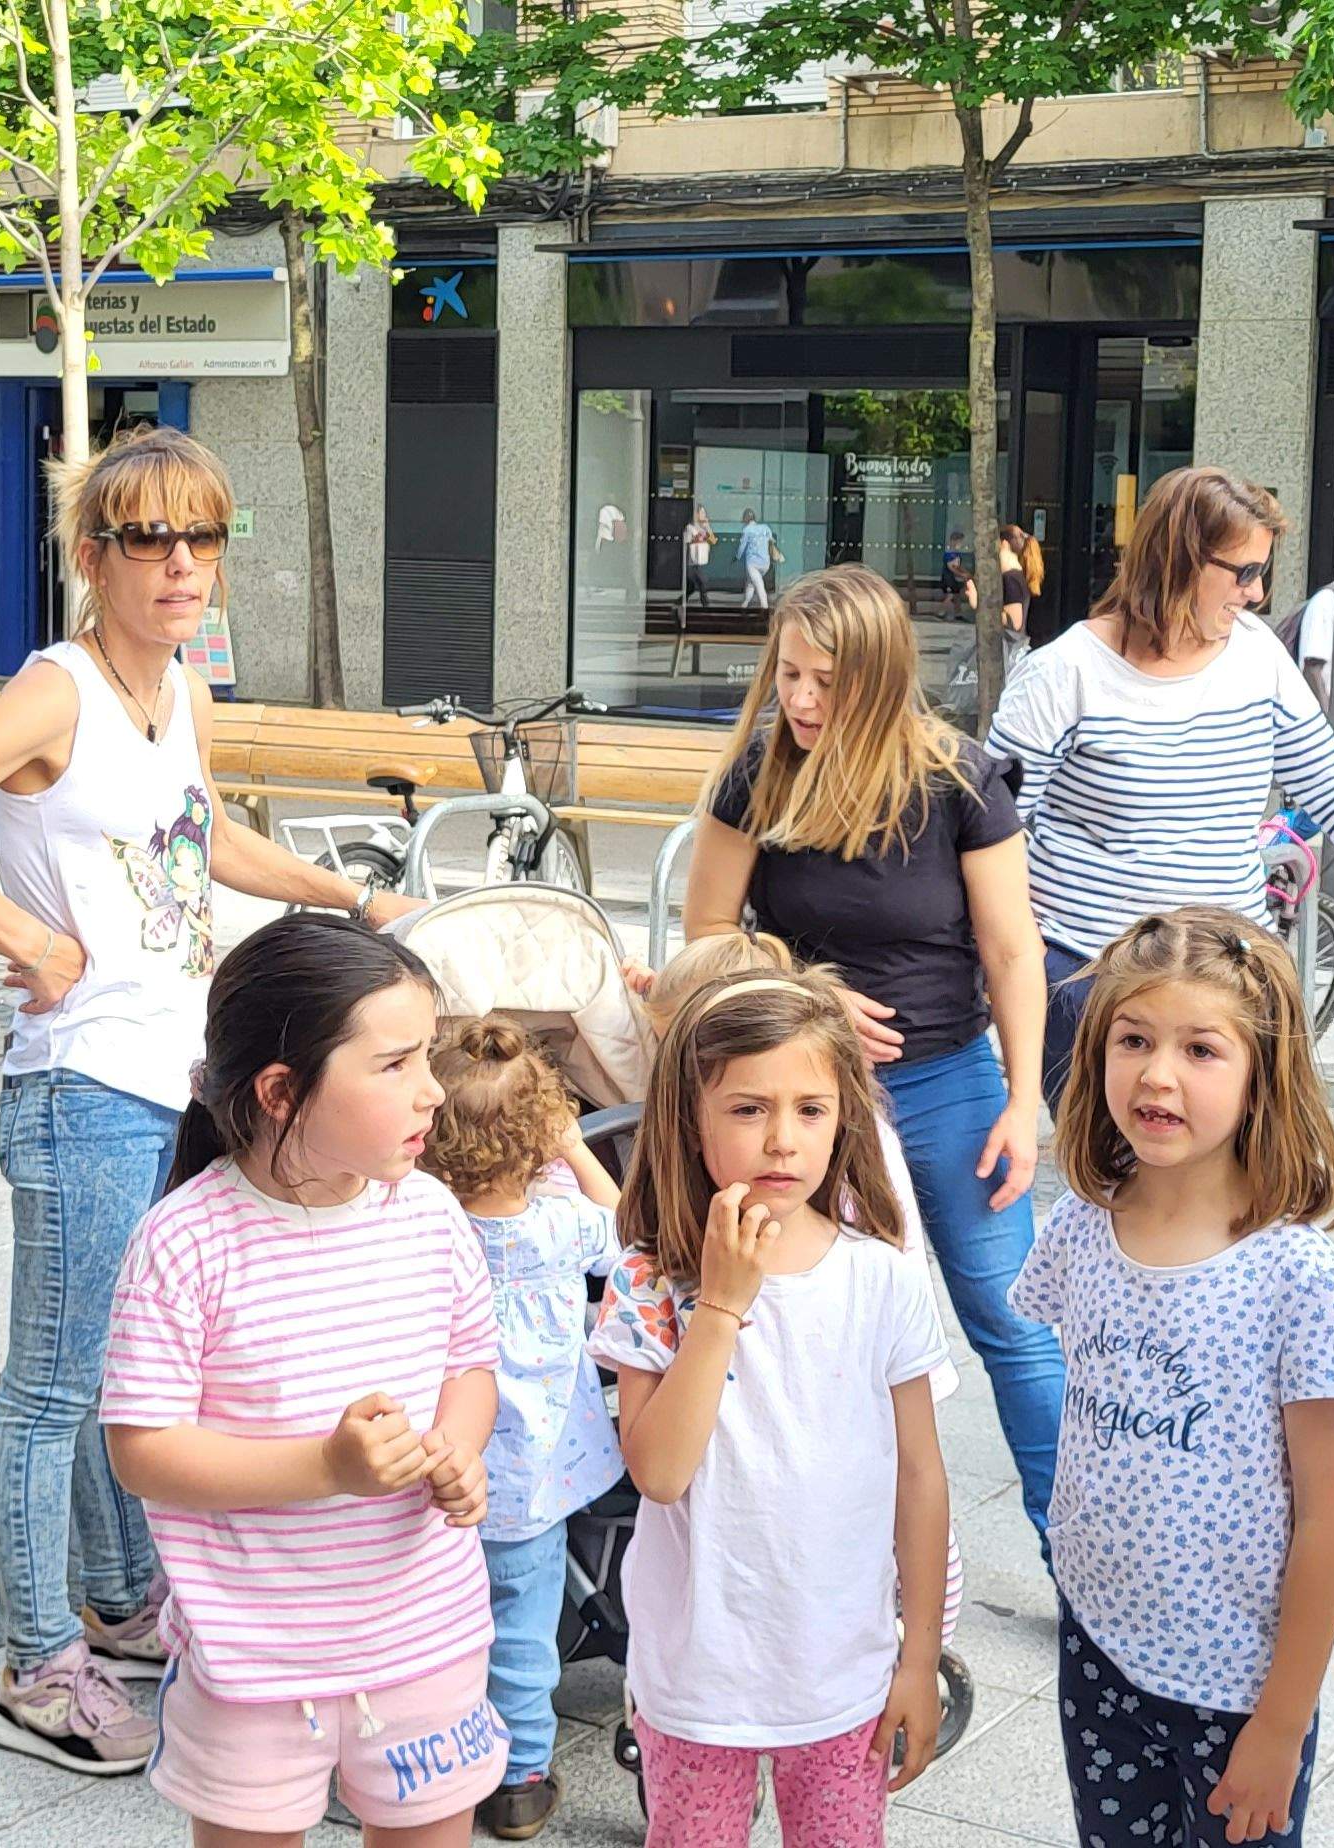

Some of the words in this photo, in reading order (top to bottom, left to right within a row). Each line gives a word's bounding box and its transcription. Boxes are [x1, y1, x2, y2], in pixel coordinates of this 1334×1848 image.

[87, 290, 127, 310] terías
[131, 296, 140, 314] y
[139, 315, 161, 334] del
[166, 314, 216, 334] Estado
[1075, 1318, 1132, 1366] make
[1136, 1331, 1203, 1399] today
[385, 1733, 454, 1802] NYC
